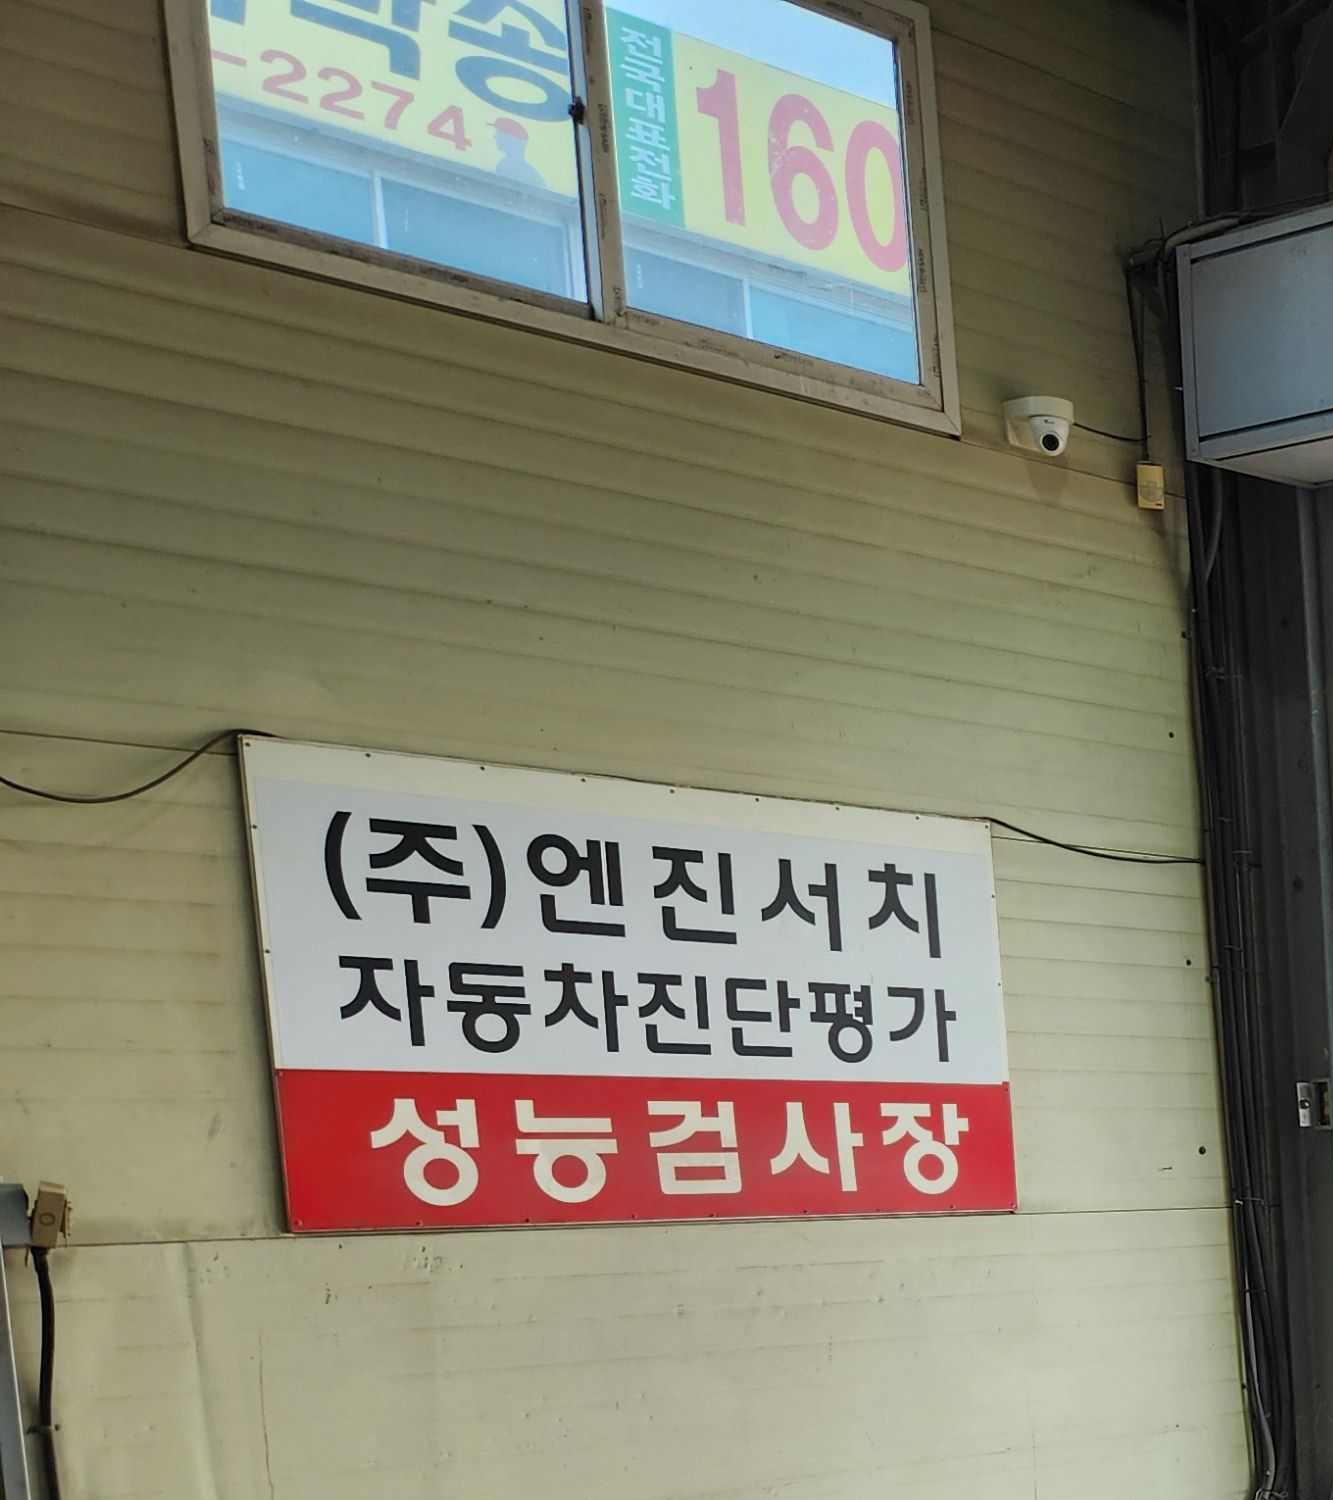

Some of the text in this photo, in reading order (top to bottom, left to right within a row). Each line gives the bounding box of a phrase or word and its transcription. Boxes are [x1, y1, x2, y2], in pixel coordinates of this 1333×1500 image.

[620, 26, 676, 211] 전국대표전화
[324, 811, 942, 958] (주)엔진서치
[338, 955, 958, 1064] 자동차진단평가
[369, 1097, 970, 1207] 성능검사장
